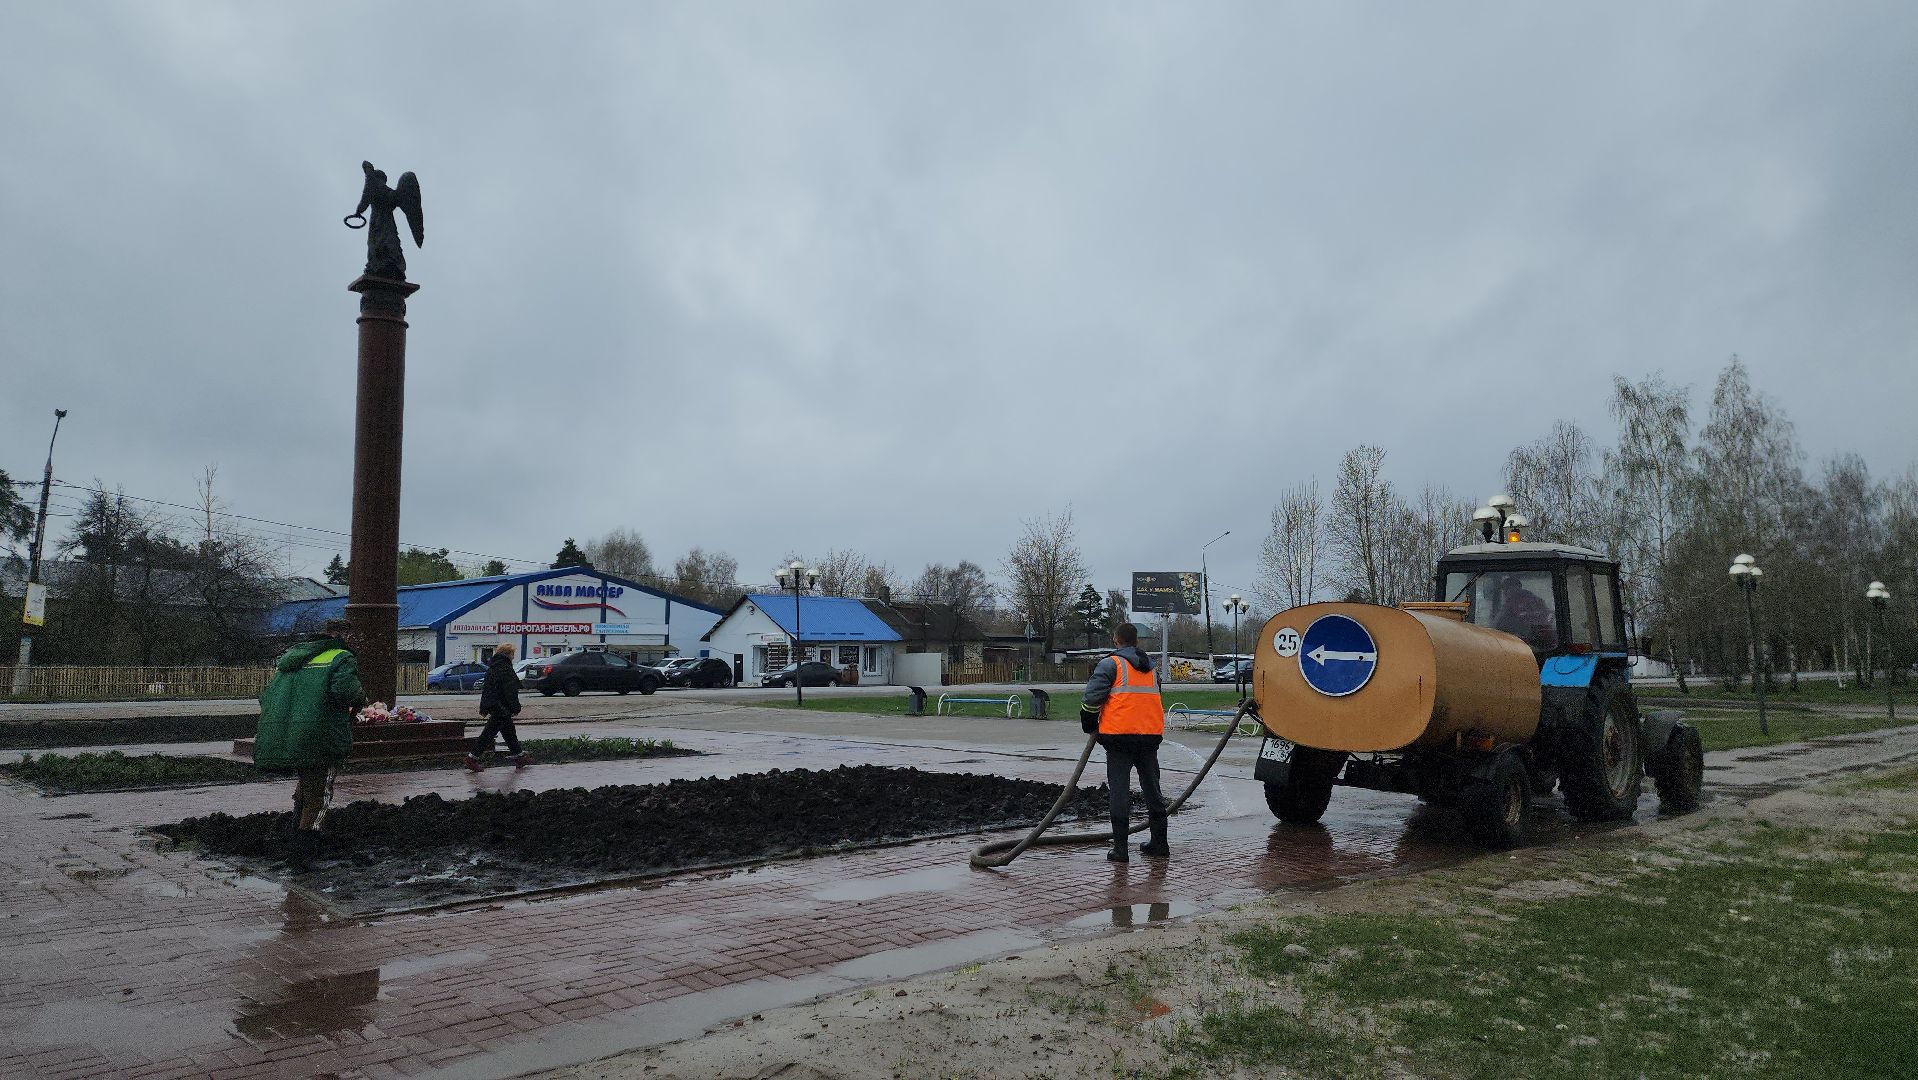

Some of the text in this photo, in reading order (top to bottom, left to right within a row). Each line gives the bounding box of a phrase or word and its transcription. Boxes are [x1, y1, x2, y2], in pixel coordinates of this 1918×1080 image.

[537, 585, 624, 599] АКВА МАСТЕР
[500, 624, 590, 633] НЕДОРОГАЯ-МЕБЕЛЬ.РФ
[1279, 634, 1298, 650] 25
